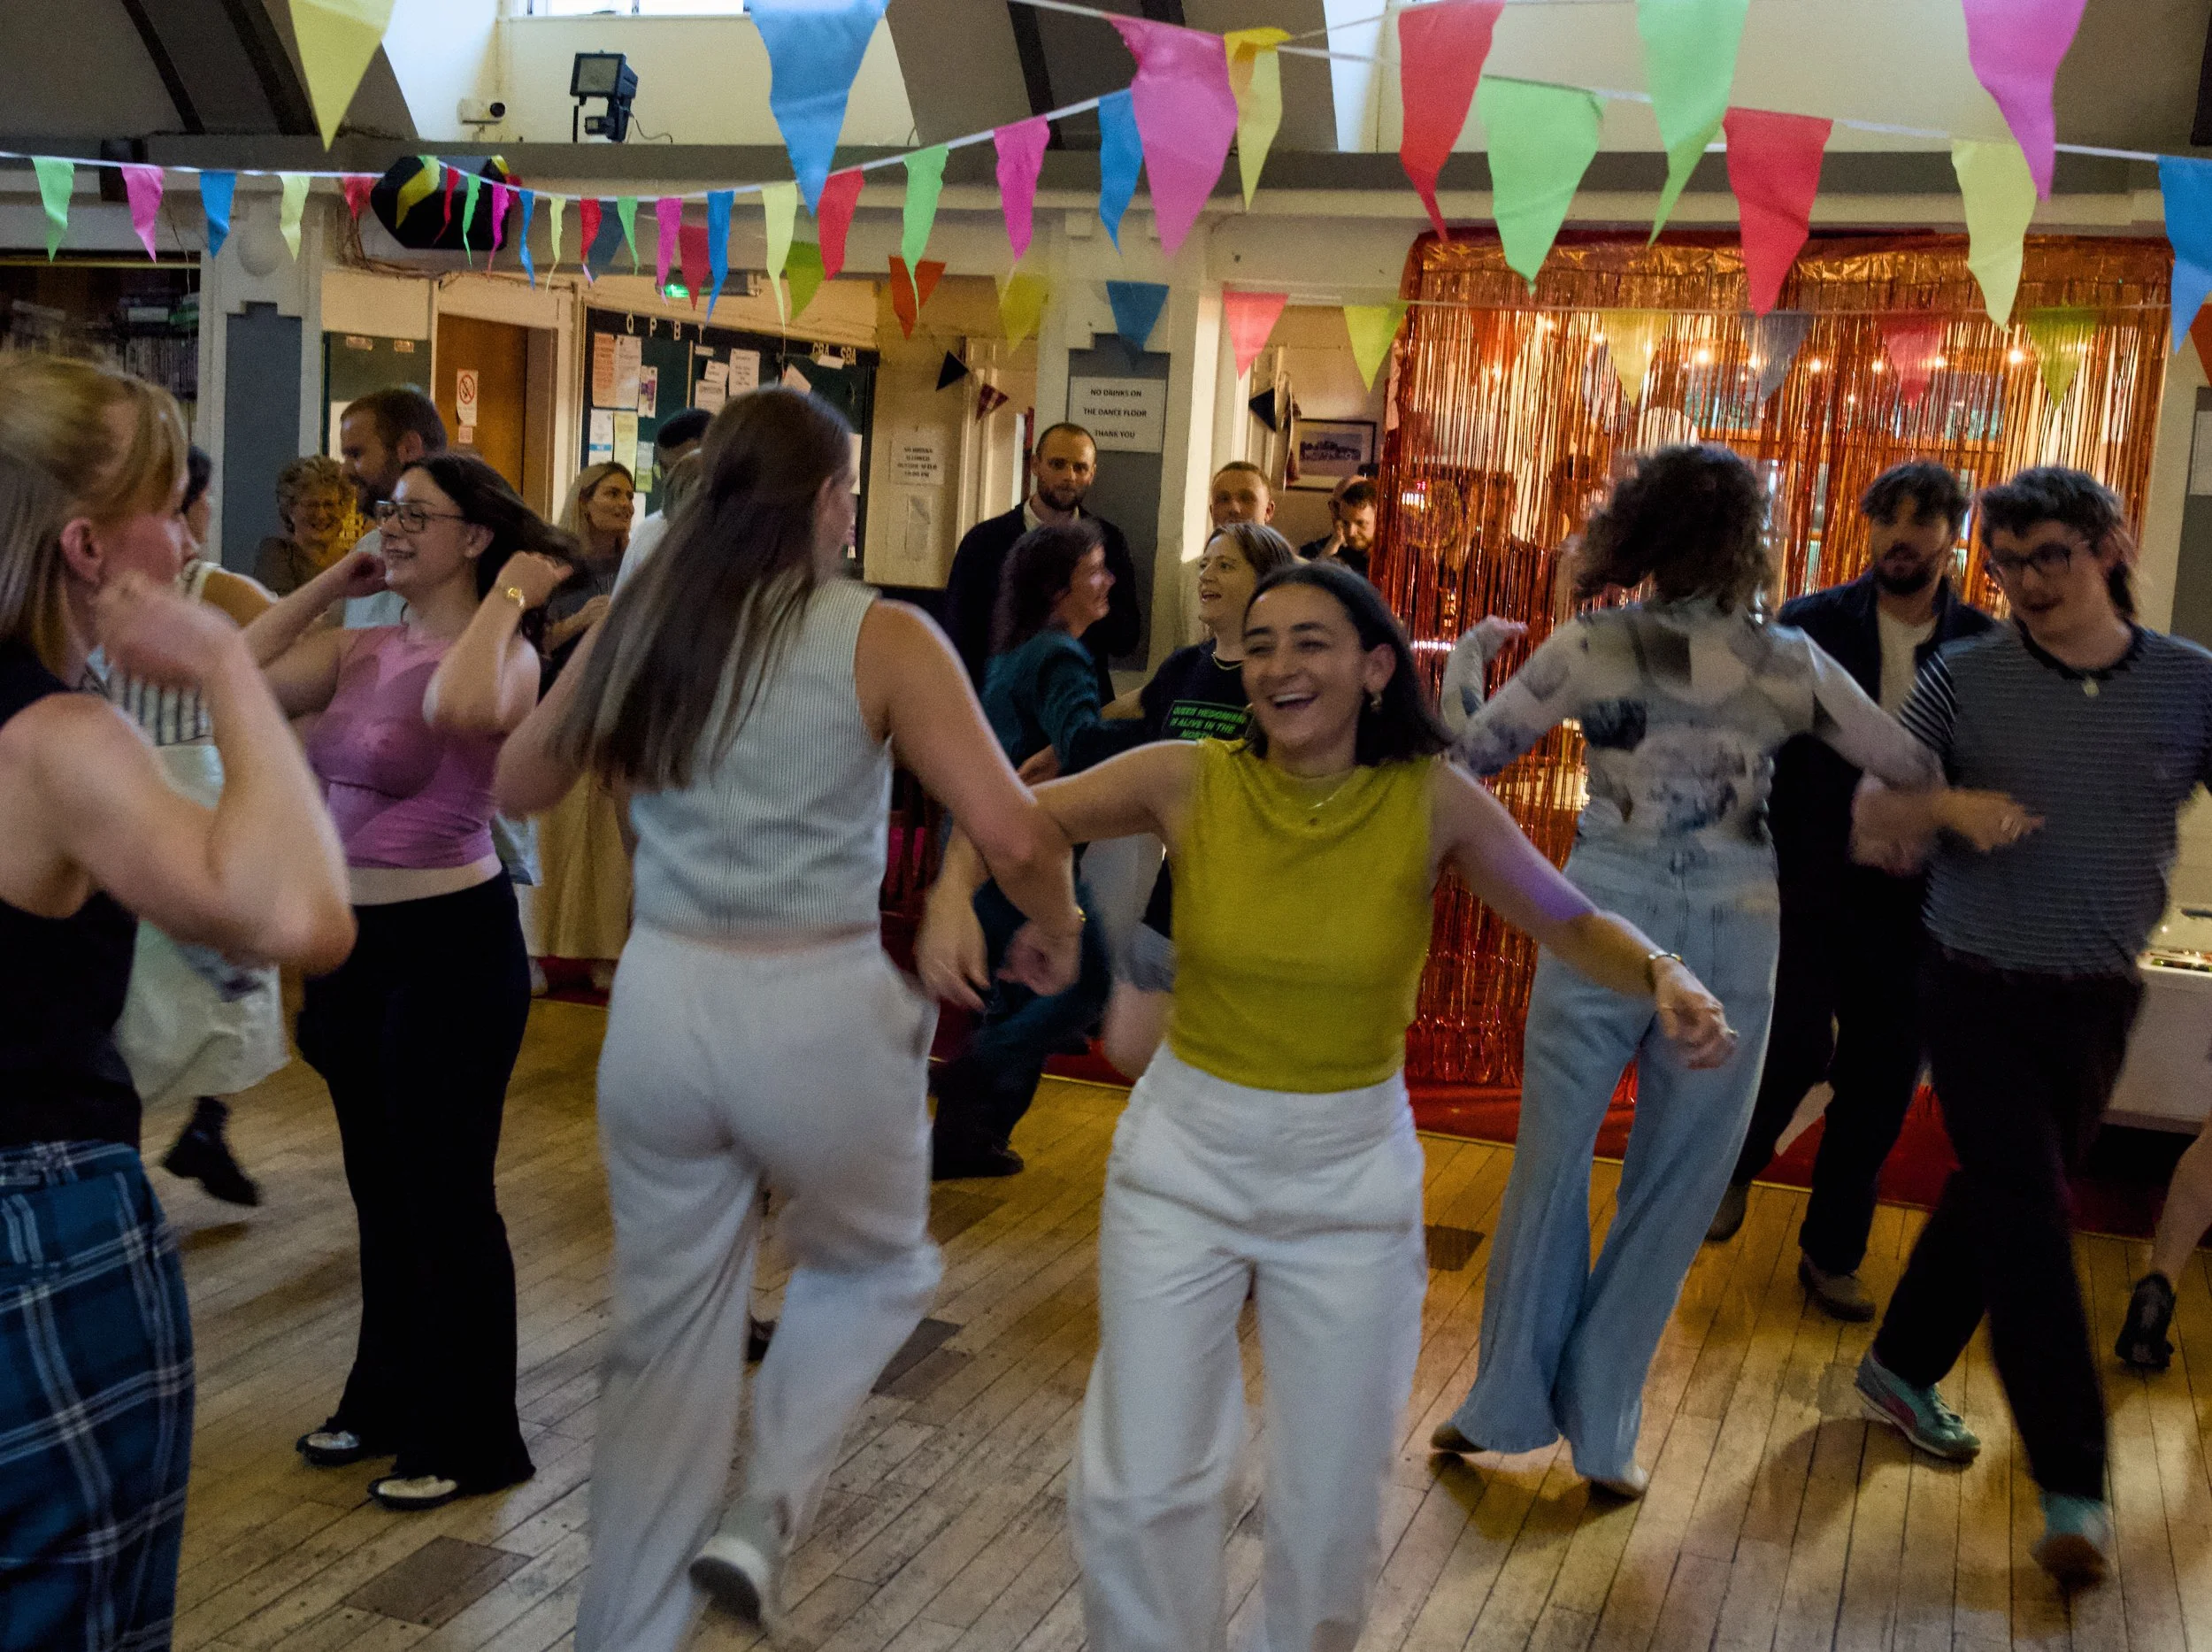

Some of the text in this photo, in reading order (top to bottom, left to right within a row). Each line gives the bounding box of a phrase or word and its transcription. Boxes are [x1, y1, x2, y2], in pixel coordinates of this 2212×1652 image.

[1178, 718, 1203, 727] ALIVE
[1203, 720, 1217, 730] IN
[1216, 722, 1237, 734] THE
